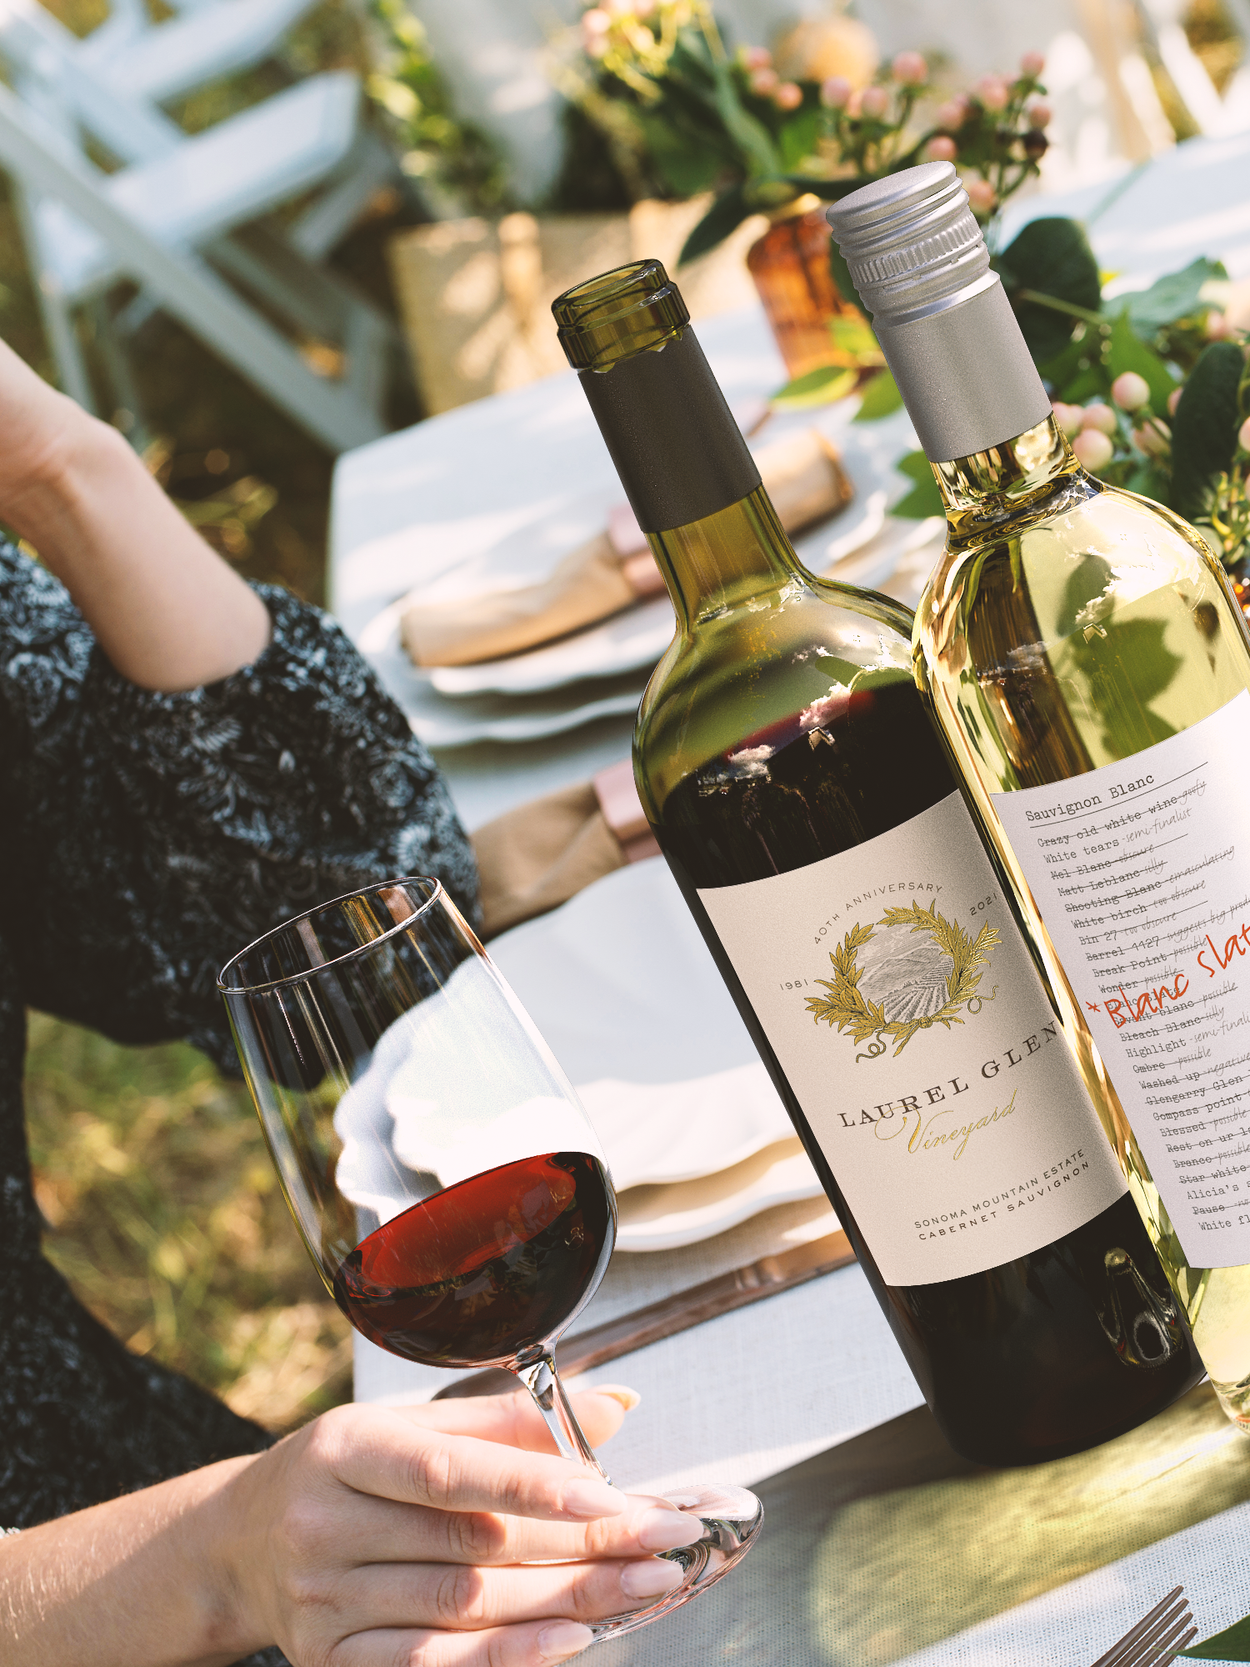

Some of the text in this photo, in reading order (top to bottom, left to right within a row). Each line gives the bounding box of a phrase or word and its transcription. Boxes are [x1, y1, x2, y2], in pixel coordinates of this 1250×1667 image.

[1025, 774, 1155, 822] Sauvignon Blanc
[1037, 835, 1070, 848] Crazy
[1076, 825, 1099, 840] old
[1104, 810, 1142, 832] white
[1148, 796, 1178, 815] wine
[1043, 851, 1077, 864] White
[1084, 839, 1120, 857] tears
[1050, 868, 1072, 880] Mel
[1076, 860, 1112, 876] Blanc
[1057, 884, 1084, 898] Matt
[1065, 896, 1120, 914] Shooting
[1125, 880, 1162, 900] Blanc
[813, 882, 943, 944] 40TH ANNIVERSARY
[969, 892, 998, 916] 2021
[1071, 914, 1105, 929] White
[1111, 904, 1147, 921] birch
[1079, 934, 1100, 946] Bin
[1105, 929, 1118, 942] 27
[1086, 946, 1125, 962] Barrel
[1131, 936, 1160, 952] 4427
[1092, 965, 1126, 979] Break
[1131, 953, 1168, 970] Point
[779, 978, 810, 991] 1981
[1098, 979, 1138, 994] Wonder
[1159, 1000, 1195, 1017] blanc
[1120, 1028, 1159, 1042] Bleach
[1165, 1016, 1201, 1033] Blanc
[1125, 1038, 1187, 1058] Highlight
[837, 1020, 1058, 1128] LAUREL GLEN
[1132, 1061, 1166, 1074] Ombre
[1138, 1074, 1180, 1090] Washed
[1185, 1071, 1201, 1082] up
[1146, 1087, 1206, 1105] Glengarry
[1212, 1075, 1244, 1091] Glen
[1153, 1106, 1199, 1121] Compass
[1206, 1092, 1242, 1112] point
[874, 1088, 1018, 1161] Vineyard
[1160, 1122, 1206, 1137] Blessed
[1166, 1141, 1193, 1153] Rest
[1199, 1138, 1213, 1148] on
[1219, 1132, 1234, 1143] ur
[1179, 1173, 1205, 1185] Star
[1211, 1163, 1247, 1179] white
[914, 1148, 1085, 1229] SONOMA MOUNTAIN ESTATE
[1187, 1184, 1239, 1200] Alicia's
[919, 1161, 1089, 1241] CABERNET SAUVIGNON
[1192, 1203, 1226, 1215] Pause
[1198, 1218, 1232, 1231] White
